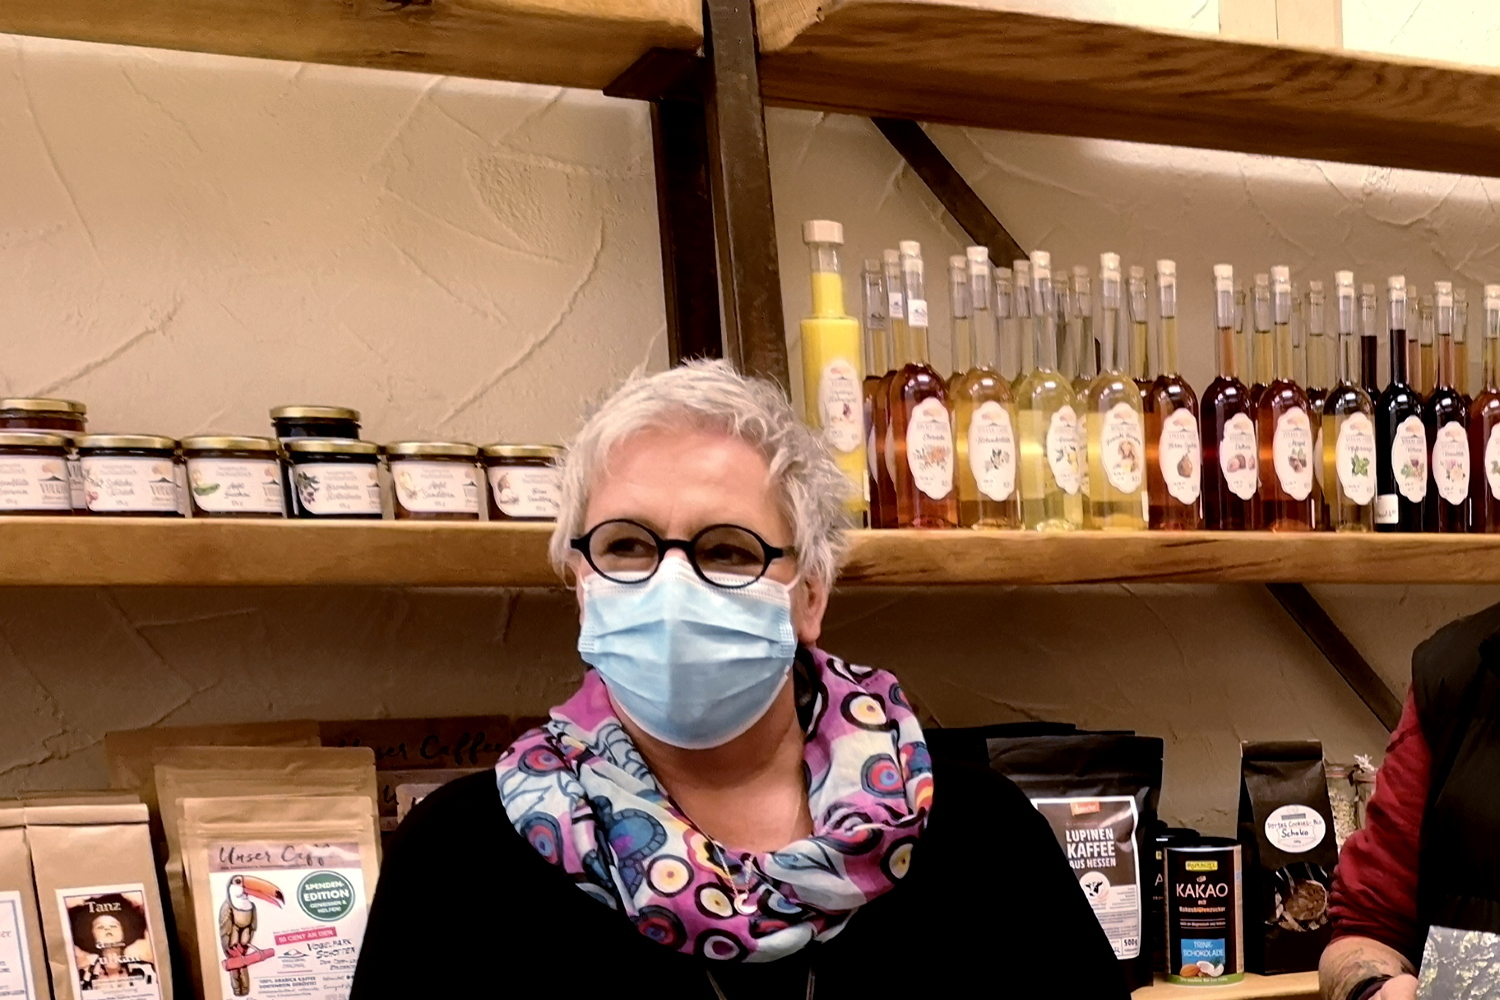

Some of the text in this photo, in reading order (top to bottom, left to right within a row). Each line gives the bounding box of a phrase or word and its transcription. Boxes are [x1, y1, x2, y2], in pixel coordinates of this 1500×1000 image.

[1065, 827, 1115, 843] LUPINEN
[218, 846, 271, 865] Unser
[1066, 841, 1117, 859] KAFFEE
[1069, 857, 1117, 870] AUS HESSEN
[304, 881, 345, 890] SPENDEN-
[1175, 882, 1229, 899] KAKAO
[303, 889, 350, 902] EDITION
[87, 901, 122, 914] Tanz
[1182, 948, 1224, 957] SCHOKOLADE
